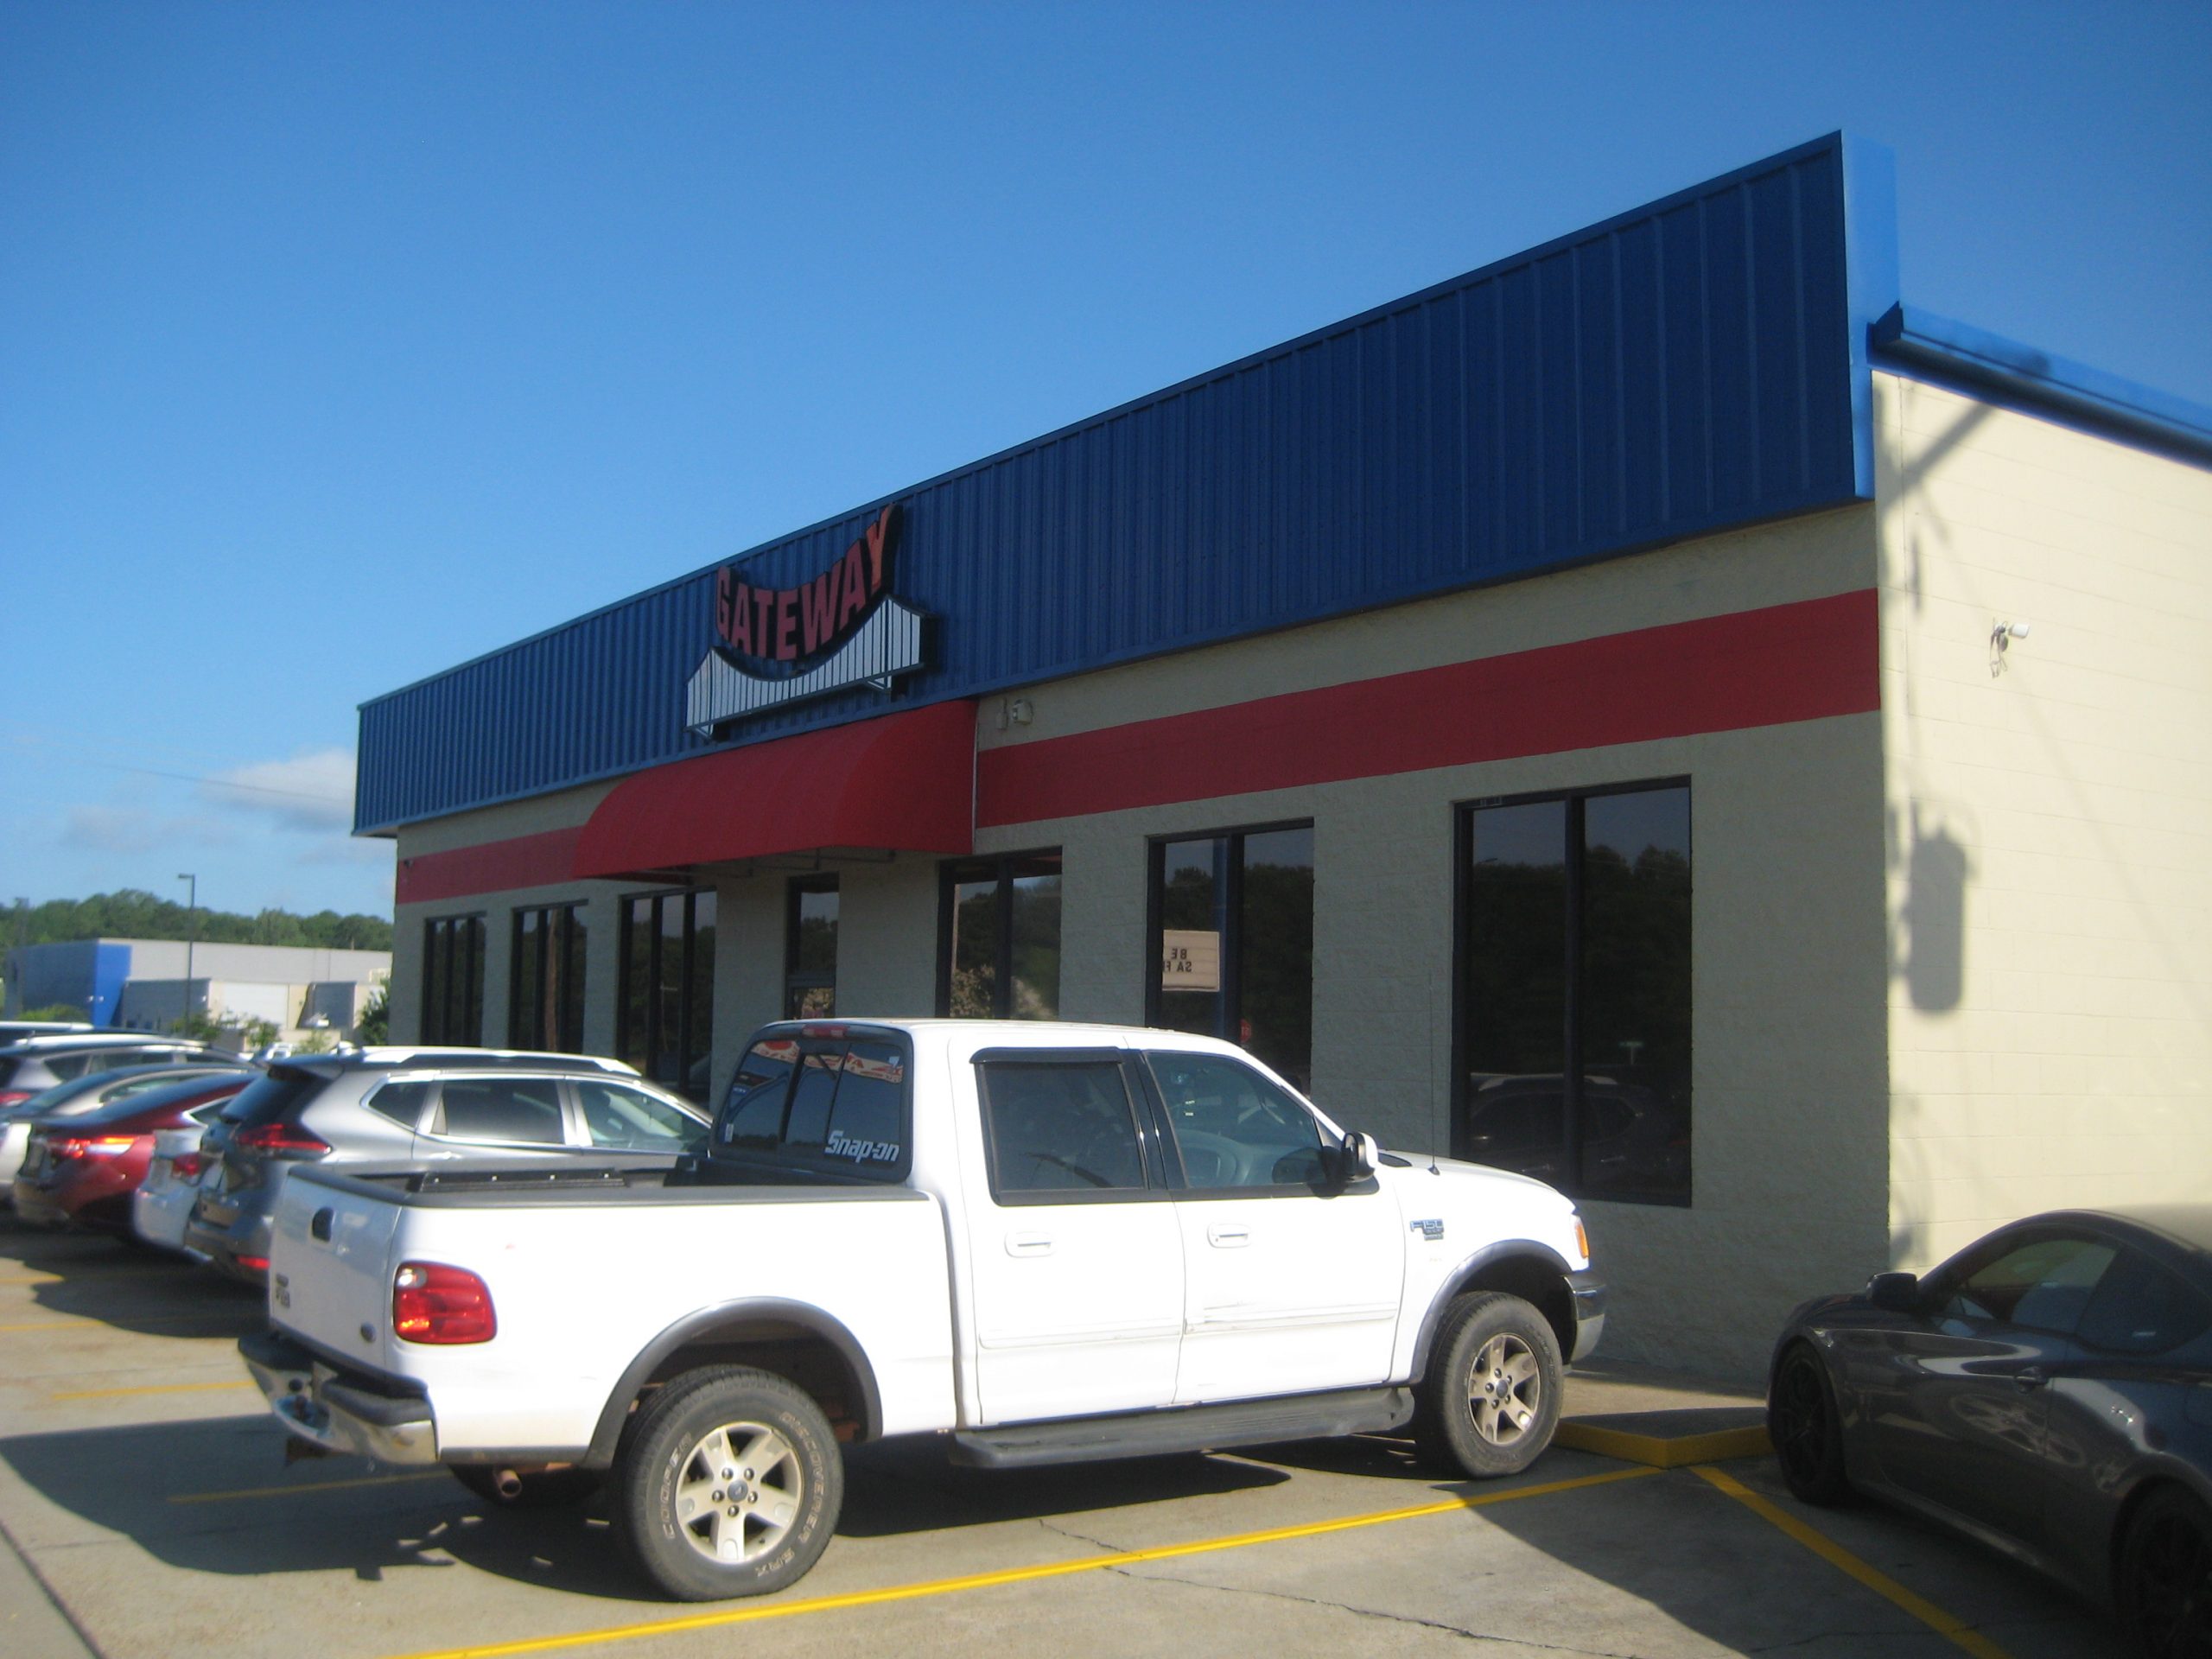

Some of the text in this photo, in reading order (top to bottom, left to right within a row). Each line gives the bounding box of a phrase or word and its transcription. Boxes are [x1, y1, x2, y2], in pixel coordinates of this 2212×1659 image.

[716, 502, 899, 662] GATEWAY
[824, 1129, 899, 1164] Snap-on
[660, 1431, 692, 1539] COOPER
